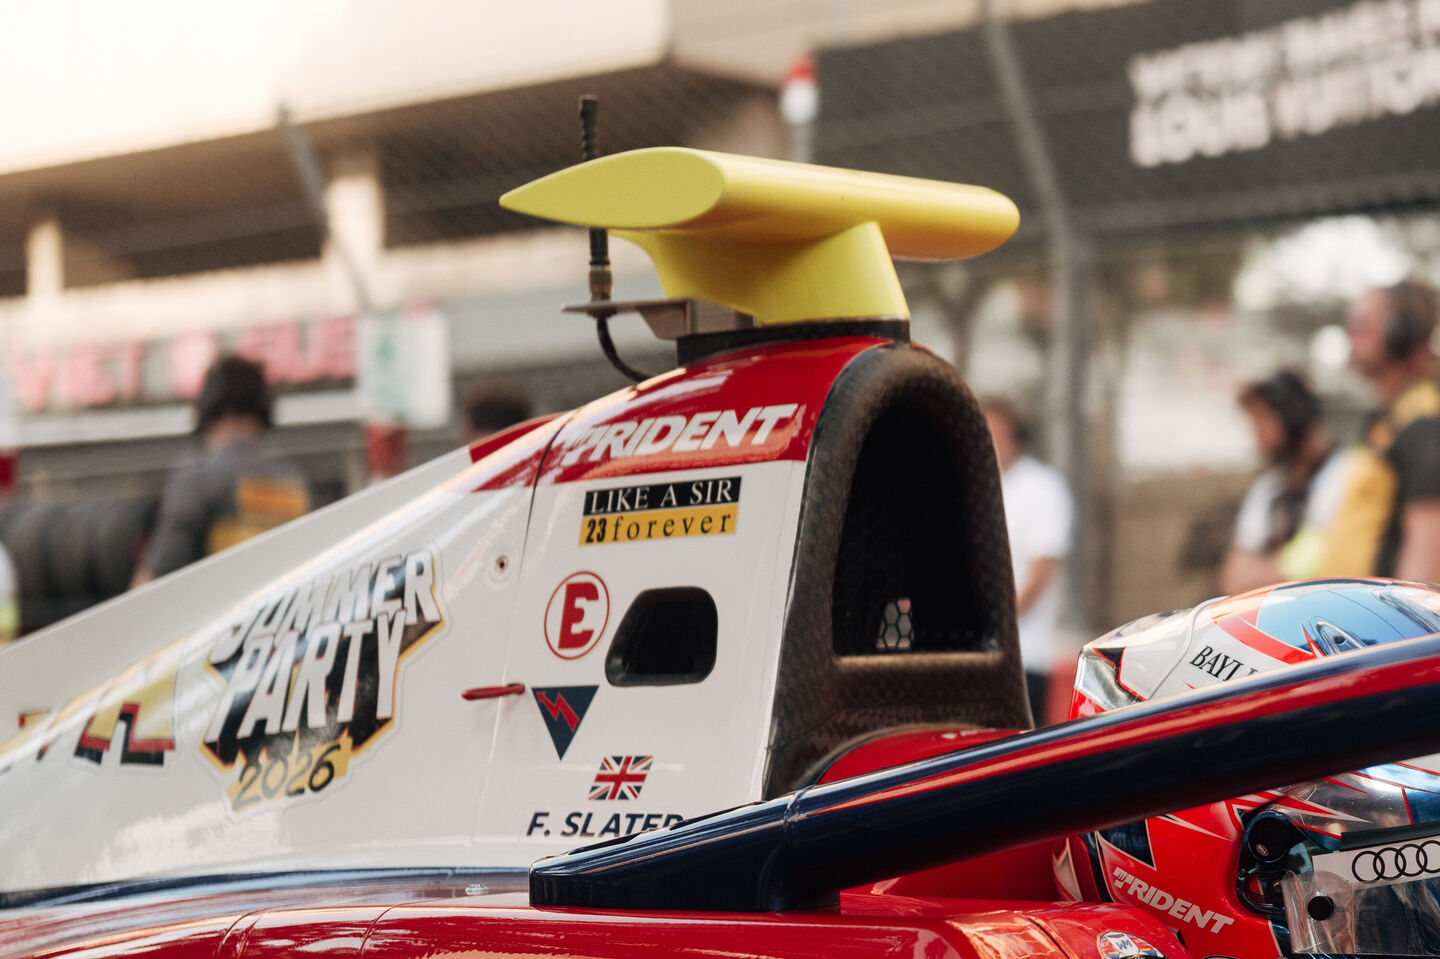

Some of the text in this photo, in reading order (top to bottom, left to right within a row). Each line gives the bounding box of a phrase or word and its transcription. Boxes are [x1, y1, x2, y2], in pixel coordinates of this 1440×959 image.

[560, 404, 798, 467] TRIDENT
[590, 479, 732, 514] LIKE A SIR
[208, 550, 441, 664] SUMMER
[558, 581, 600, 649] E
[203, 608, 407, 743] PARTY
[1189, 646, 1258, 681] BAYL
[232, 744, 341, 811] 2026
[526, 811, 551, 837] F.
[1113, 867, 1235, 934] TRIDENT
